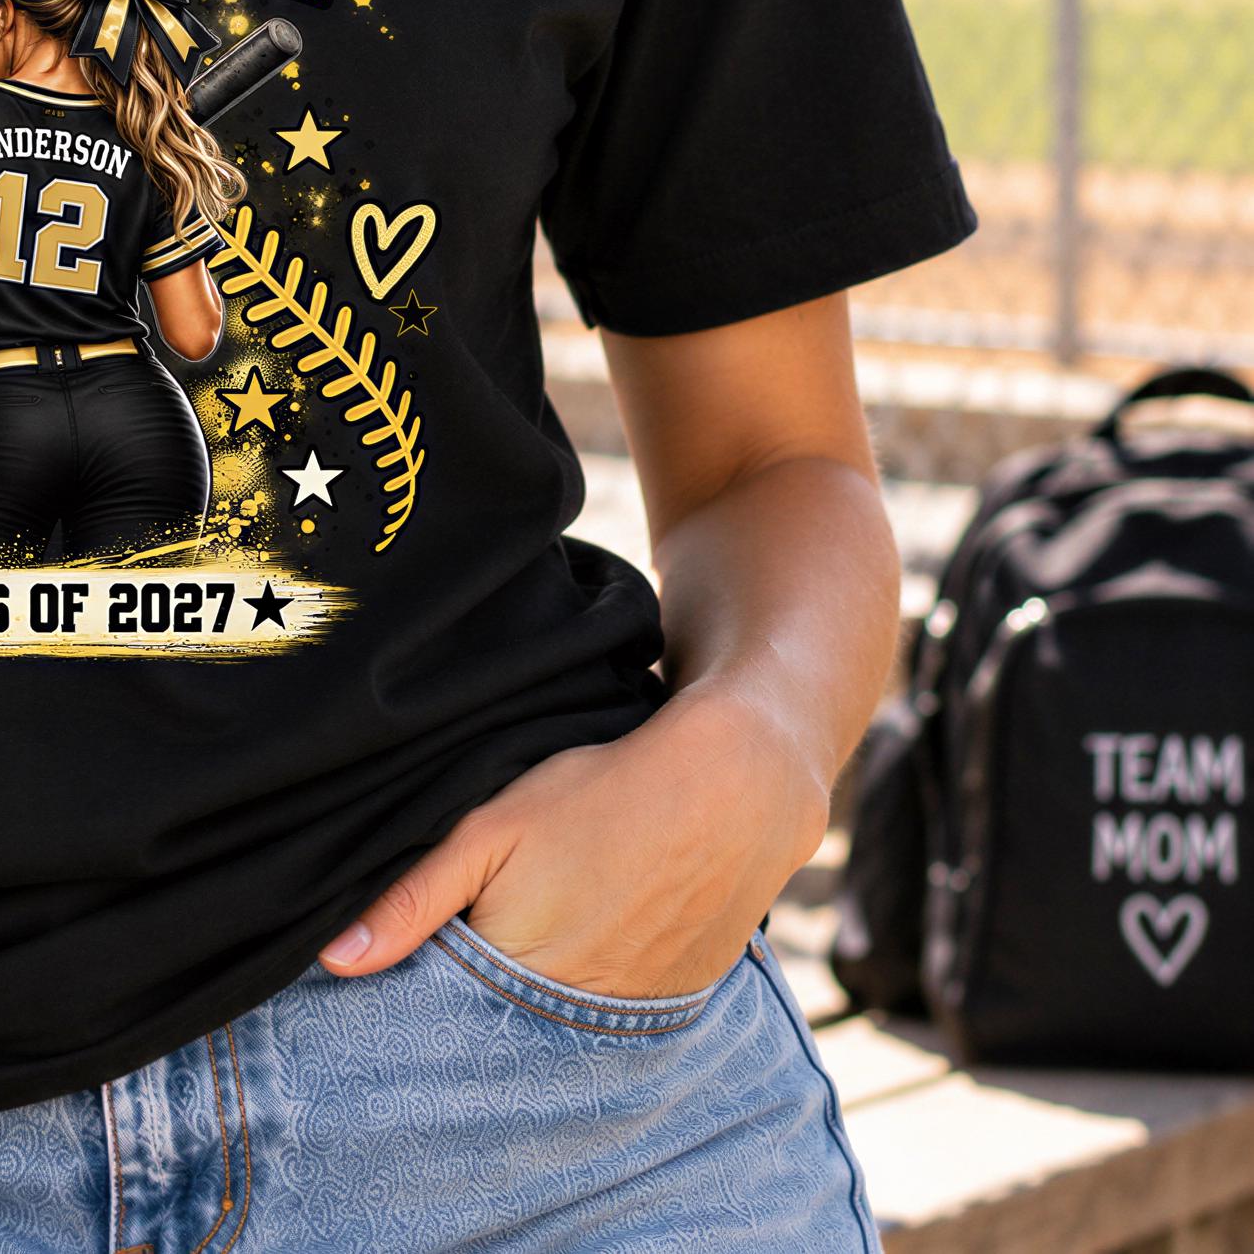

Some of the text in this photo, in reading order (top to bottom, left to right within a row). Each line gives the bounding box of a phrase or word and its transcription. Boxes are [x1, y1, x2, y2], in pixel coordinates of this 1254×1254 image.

[30, 583, 89, 633] OF
[108, 583, 236, 634] 2027
[1084, 732, 1245, 804] TEAM
[1091, 810, 1238, 883] MOM
